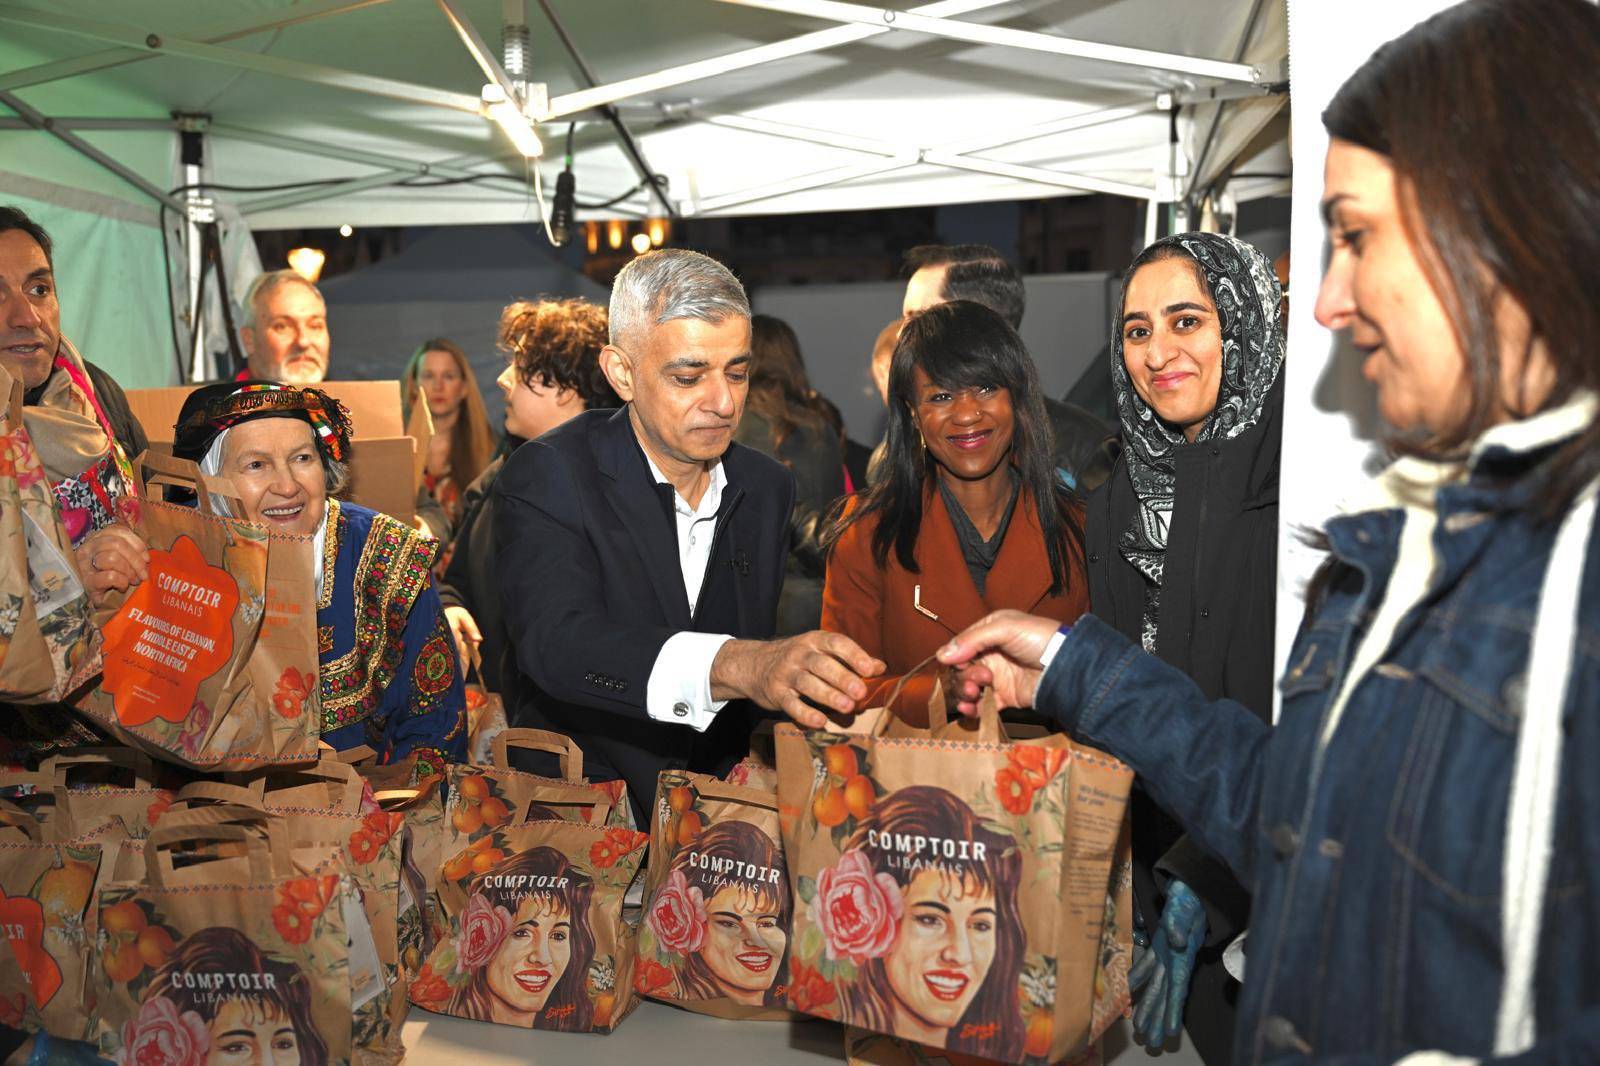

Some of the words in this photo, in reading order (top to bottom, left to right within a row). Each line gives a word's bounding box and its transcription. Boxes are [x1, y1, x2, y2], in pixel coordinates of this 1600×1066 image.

[157, 572, 221, 608] COMPTOIR
[162, 593, 204, 617] LIBANAIS
[128, 607, 170, 634] FLAVOURS
[169, 624, 183, 637] OF
[140, 629, 172, 651] MIDDLE
[132, 641, 165, 663] NORTH
[162, 653, 188, 673] AFRICA
[867, 829, 986, 862] COMPTOIR
[689, 851, 781, 885] COMPTOIR
[886, 854, 963, 878] LIBANAIS
[484, 874, 569, 889] COMPTOIR
[701, 873, 760, 894] LIBANAIS
[500, 890, 552, 901] LIBANAIS
[171, 971, 277, 990] COMPTOIR
[193, 992, 260, 1004] LIBANAIS
